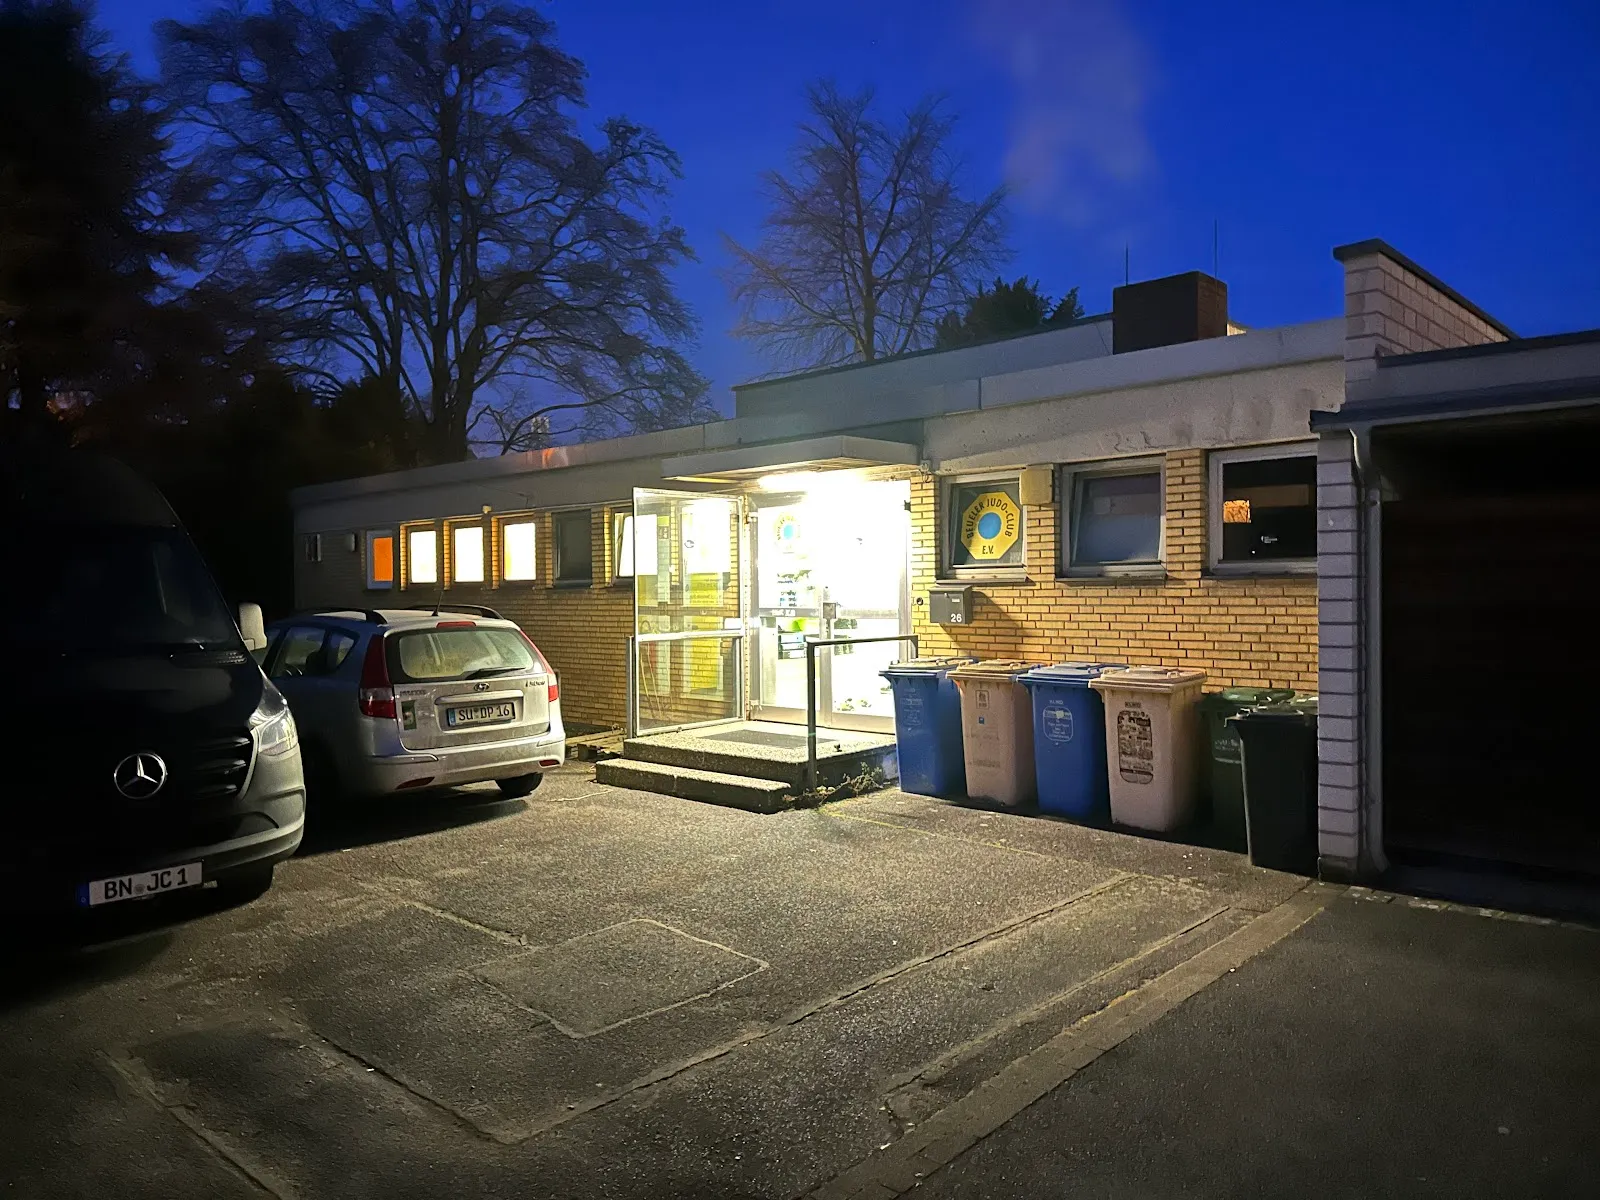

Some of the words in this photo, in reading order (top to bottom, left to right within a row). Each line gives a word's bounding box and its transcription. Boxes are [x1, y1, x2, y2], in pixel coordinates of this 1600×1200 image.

[966, 501, 985, 539] BEUELER
[986, 498, 1015, 537] JUDO-CLUB
[982, 545, 994, 554] E.V.
[950, 613, 962, 623] 26
[458, 708, 473, 721] SU
[480, 706, 493, 718] DP
[497, 704, 510, 717] 16
[104, 878, 132, 899] BN
[146, 871, 172, 891] JC
[177, 868, 188, 886] 1
